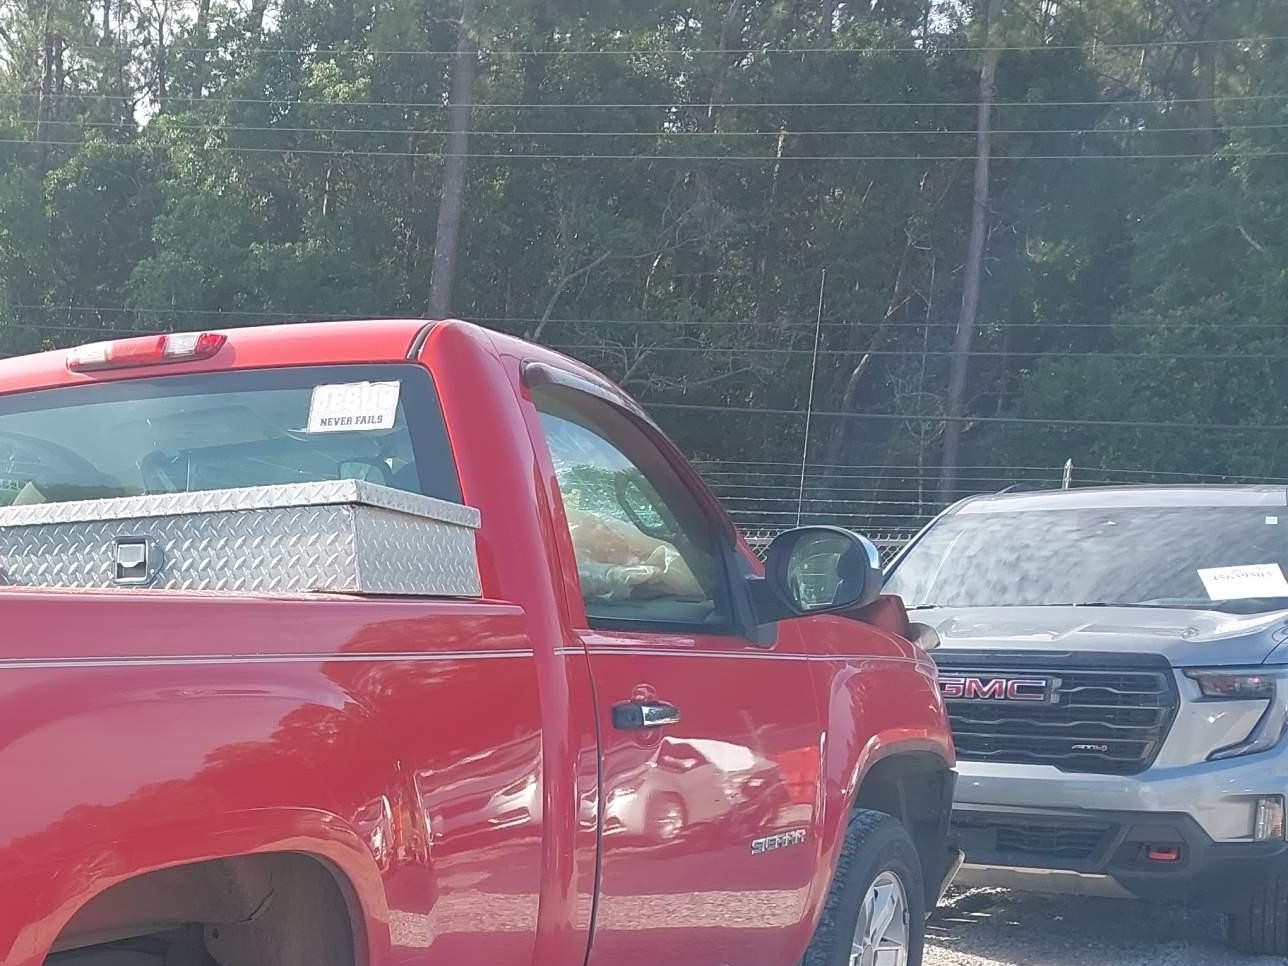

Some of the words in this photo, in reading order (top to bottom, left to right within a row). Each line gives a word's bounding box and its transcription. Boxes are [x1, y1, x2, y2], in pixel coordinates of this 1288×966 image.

[320, 416, 352, 426] NEVER
[355, 415, 383, 424] FAILS
[938, 677, 1047, 701] GMC
